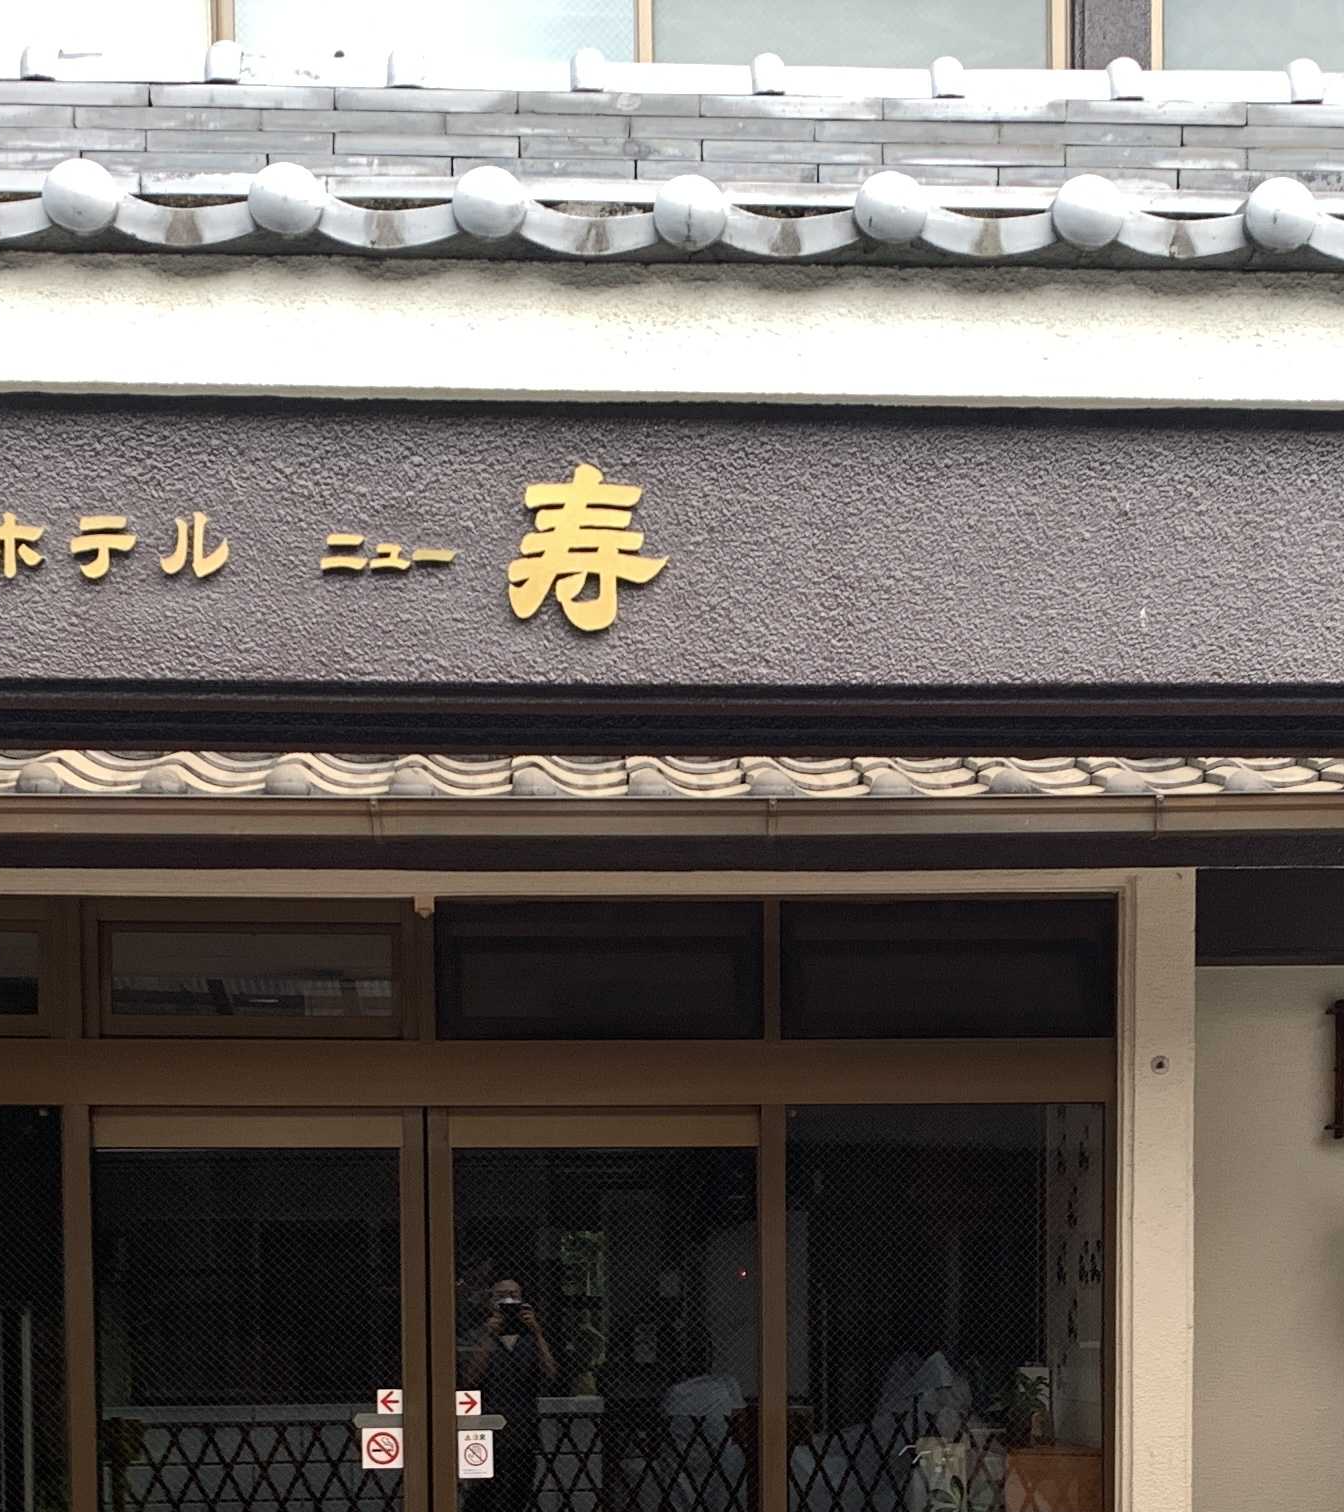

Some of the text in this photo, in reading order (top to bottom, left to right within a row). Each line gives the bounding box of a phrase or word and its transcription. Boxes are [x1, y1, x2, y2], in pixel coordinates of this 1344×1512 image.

[319, 532, 457, 573] ニュー
[507, 463, 670, 633] 寿
